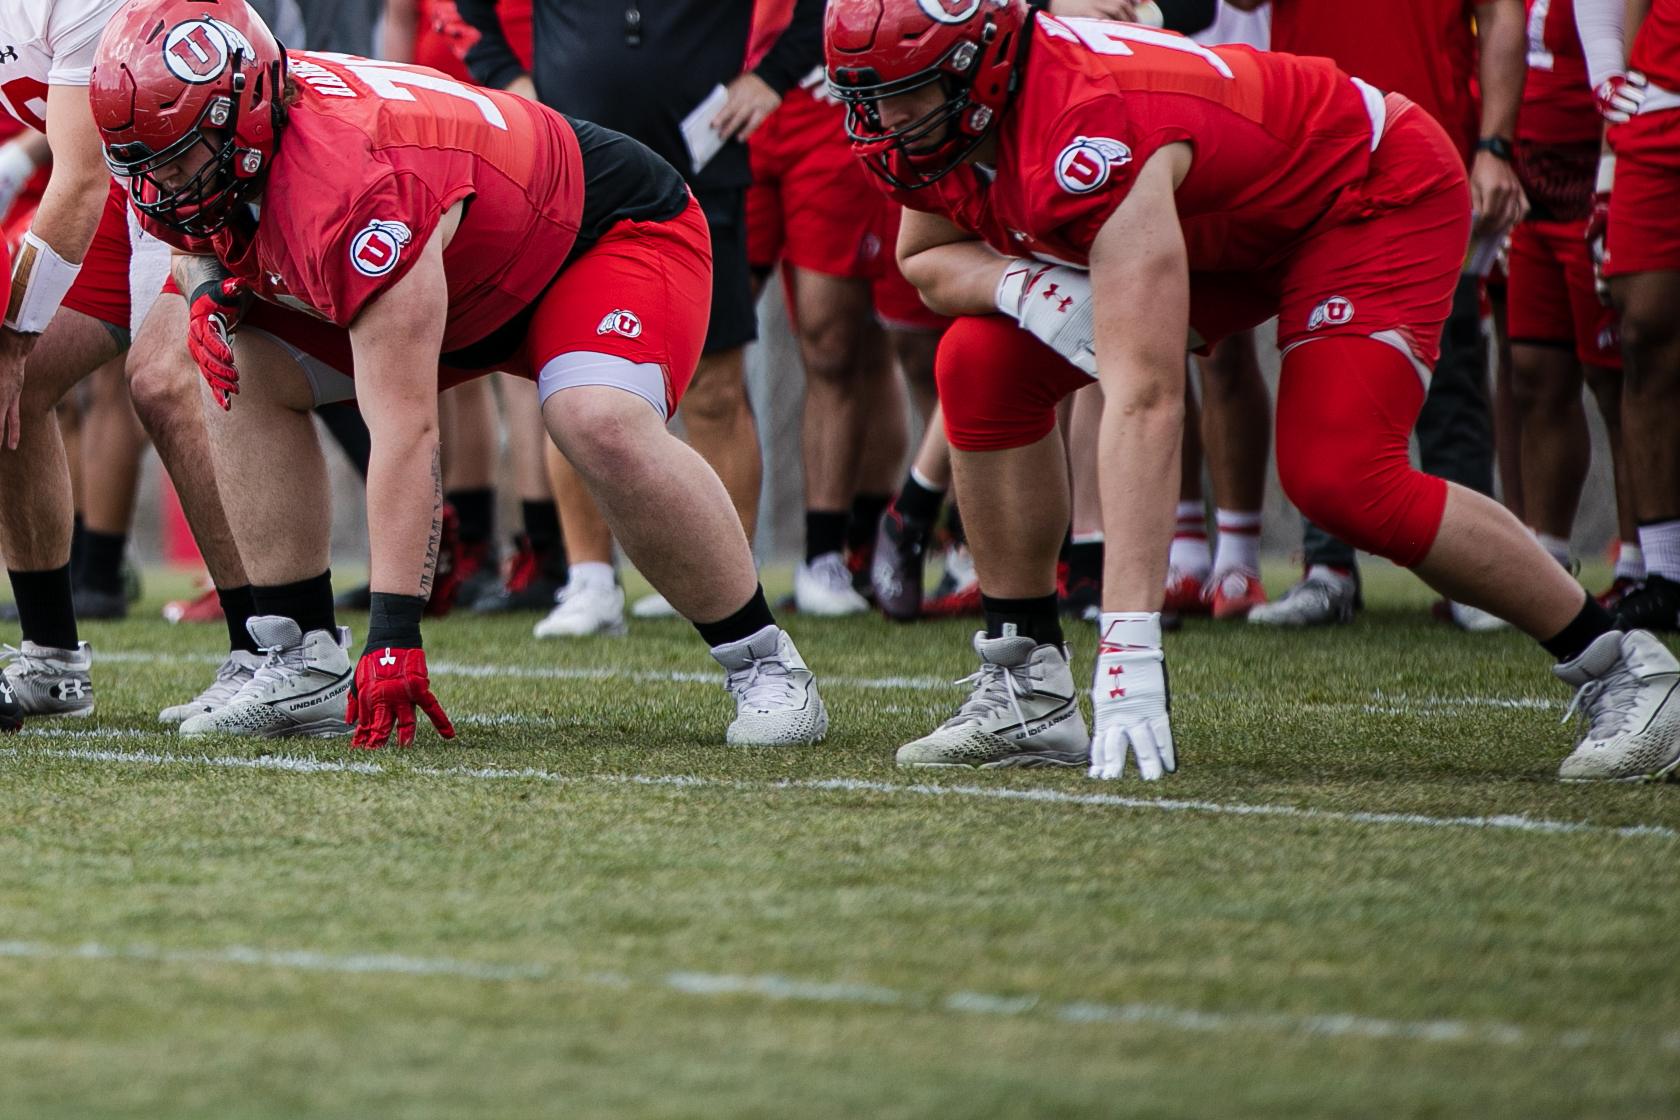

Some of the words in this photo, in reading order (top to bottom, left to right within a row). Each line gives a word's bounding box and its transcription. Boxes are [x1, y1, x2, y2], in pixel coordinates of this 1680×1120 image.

[169, 25, 222, 77] U
[1055, 15, 1235, 79] 7
[304, 50, 508, 130] 7
[1064, 150, 1101, 186] U
[357, 233, 393, 268] U
[618, 314, 638, 334] U
[1327, 301, 1348, 320] U
[289, 697, 323, 712] UNDER
